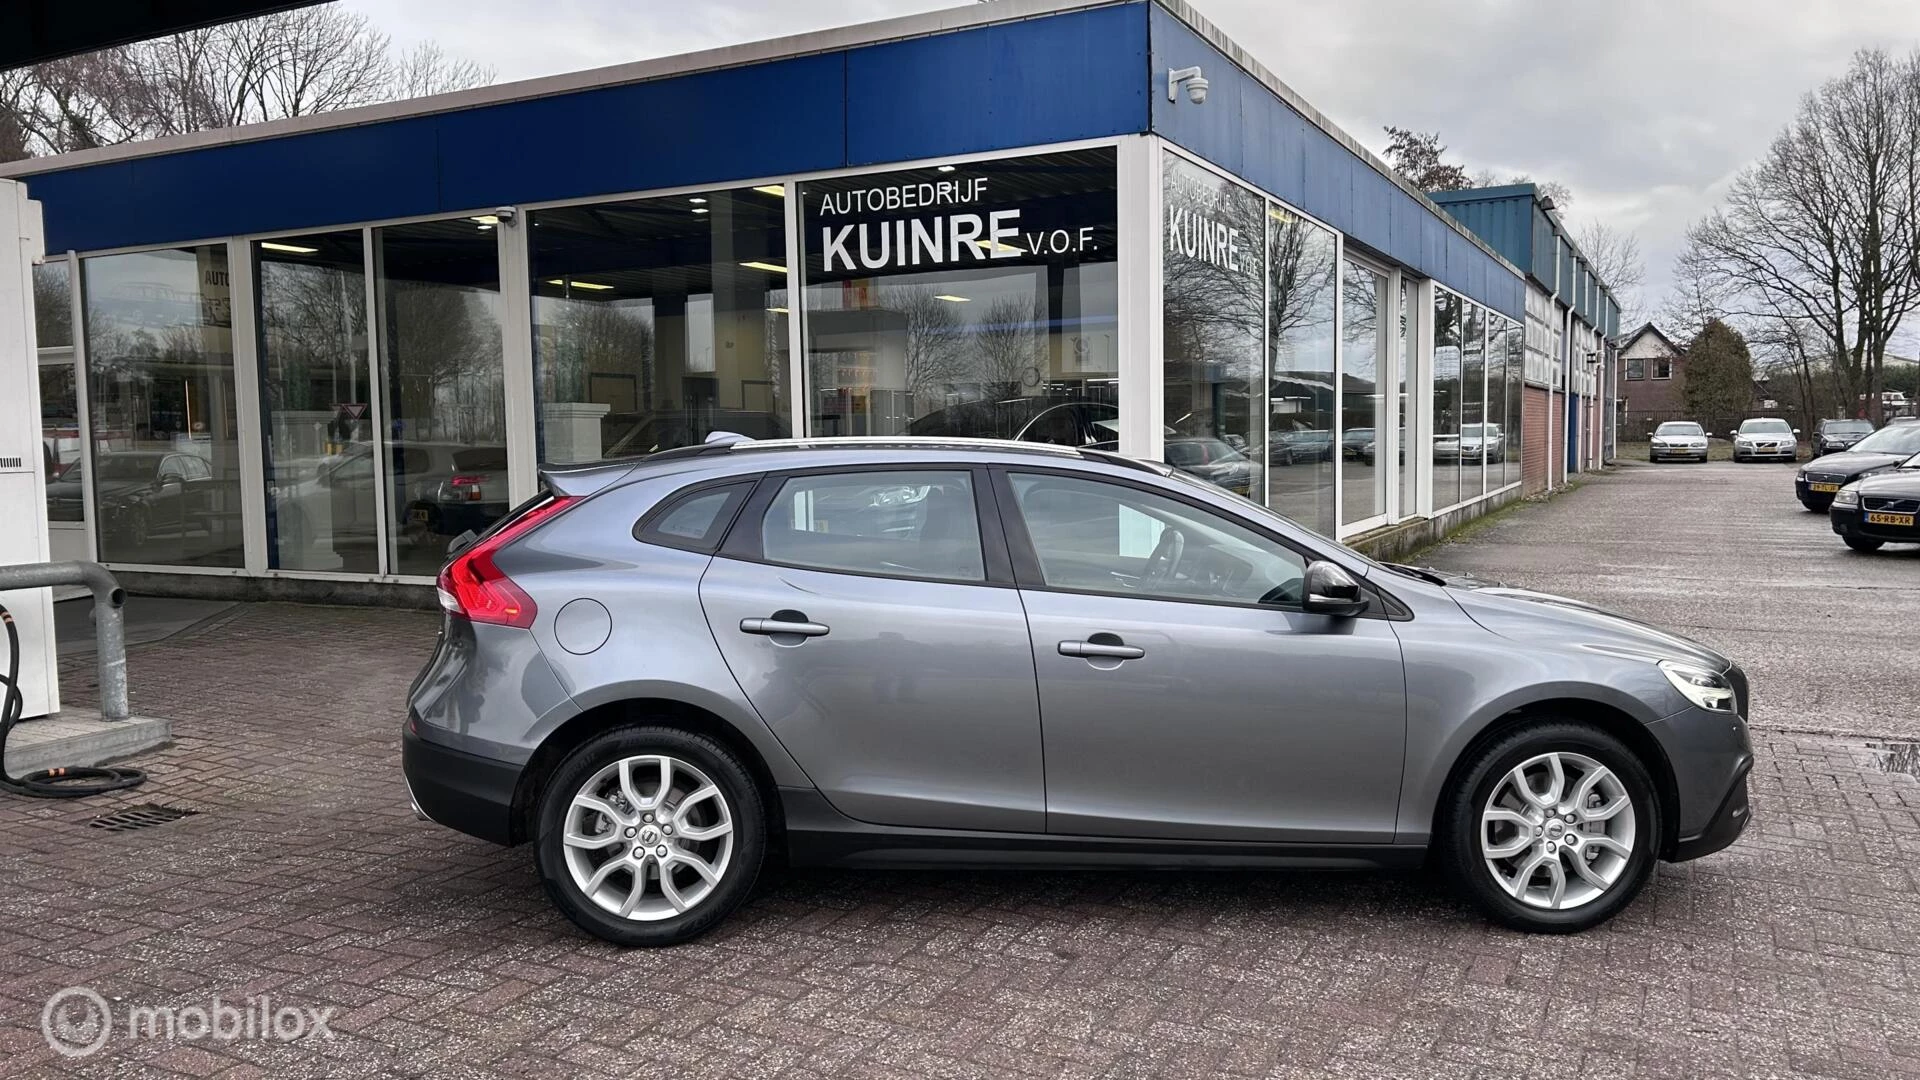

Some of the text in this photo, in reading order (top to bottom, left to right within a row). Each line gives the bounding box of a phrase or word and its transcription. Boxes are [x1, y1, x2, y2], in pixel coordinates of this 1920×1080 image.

[819, 176, 989, 216] AUTOBEDRIJF
[1170, 167, 1231, 213] AUTOBEDRIJF
[822, 208, 1099, 273] KUINRE V.O.F.
[1170, 203, 1239, 272] KUINRE
[1870, 514, 1911, 524] 65-RB-XR
